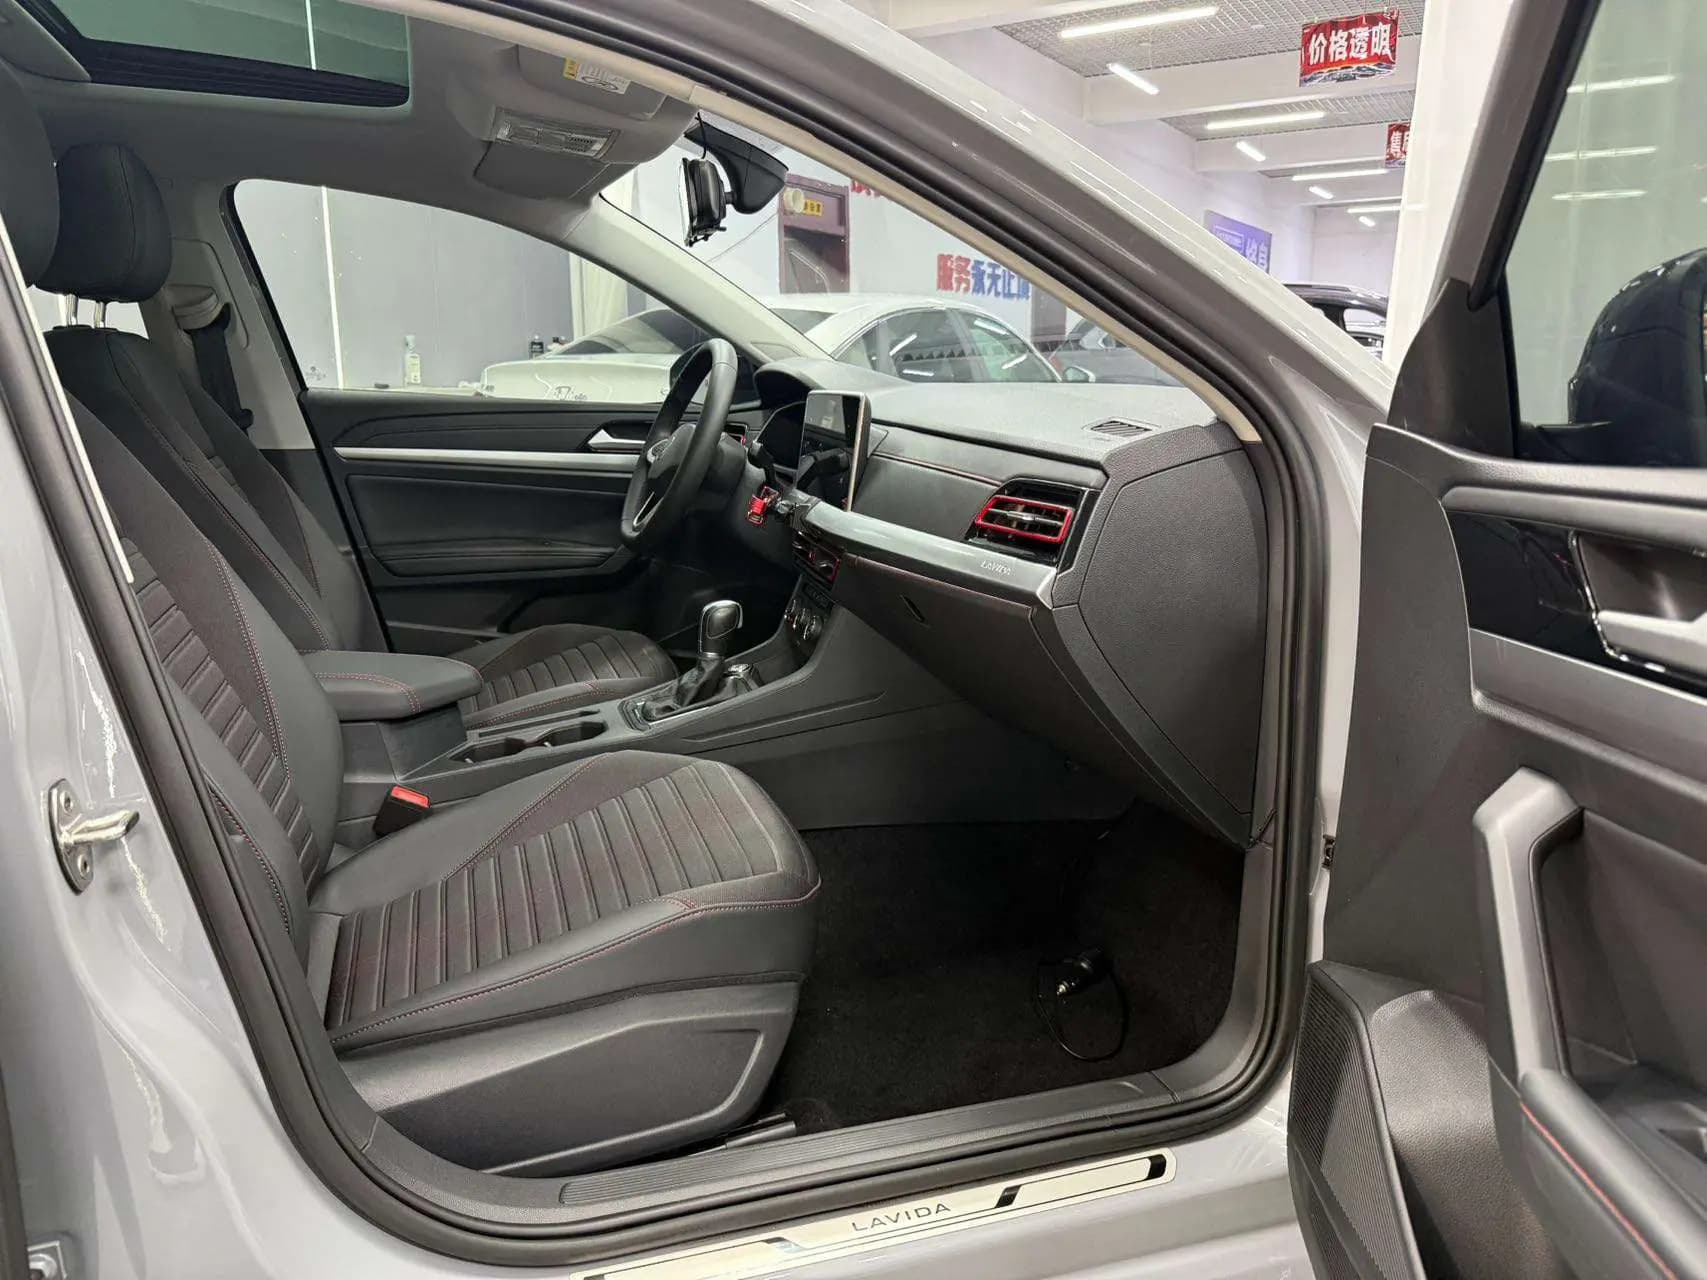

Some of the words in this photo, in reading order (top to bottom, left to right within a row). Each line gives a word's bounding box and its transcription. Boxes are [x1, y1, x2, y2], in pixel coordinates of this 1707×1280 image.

[1309, 22, 1393, 65] 价格透明
[852, 1203, 951, 1231] LAVIDA
